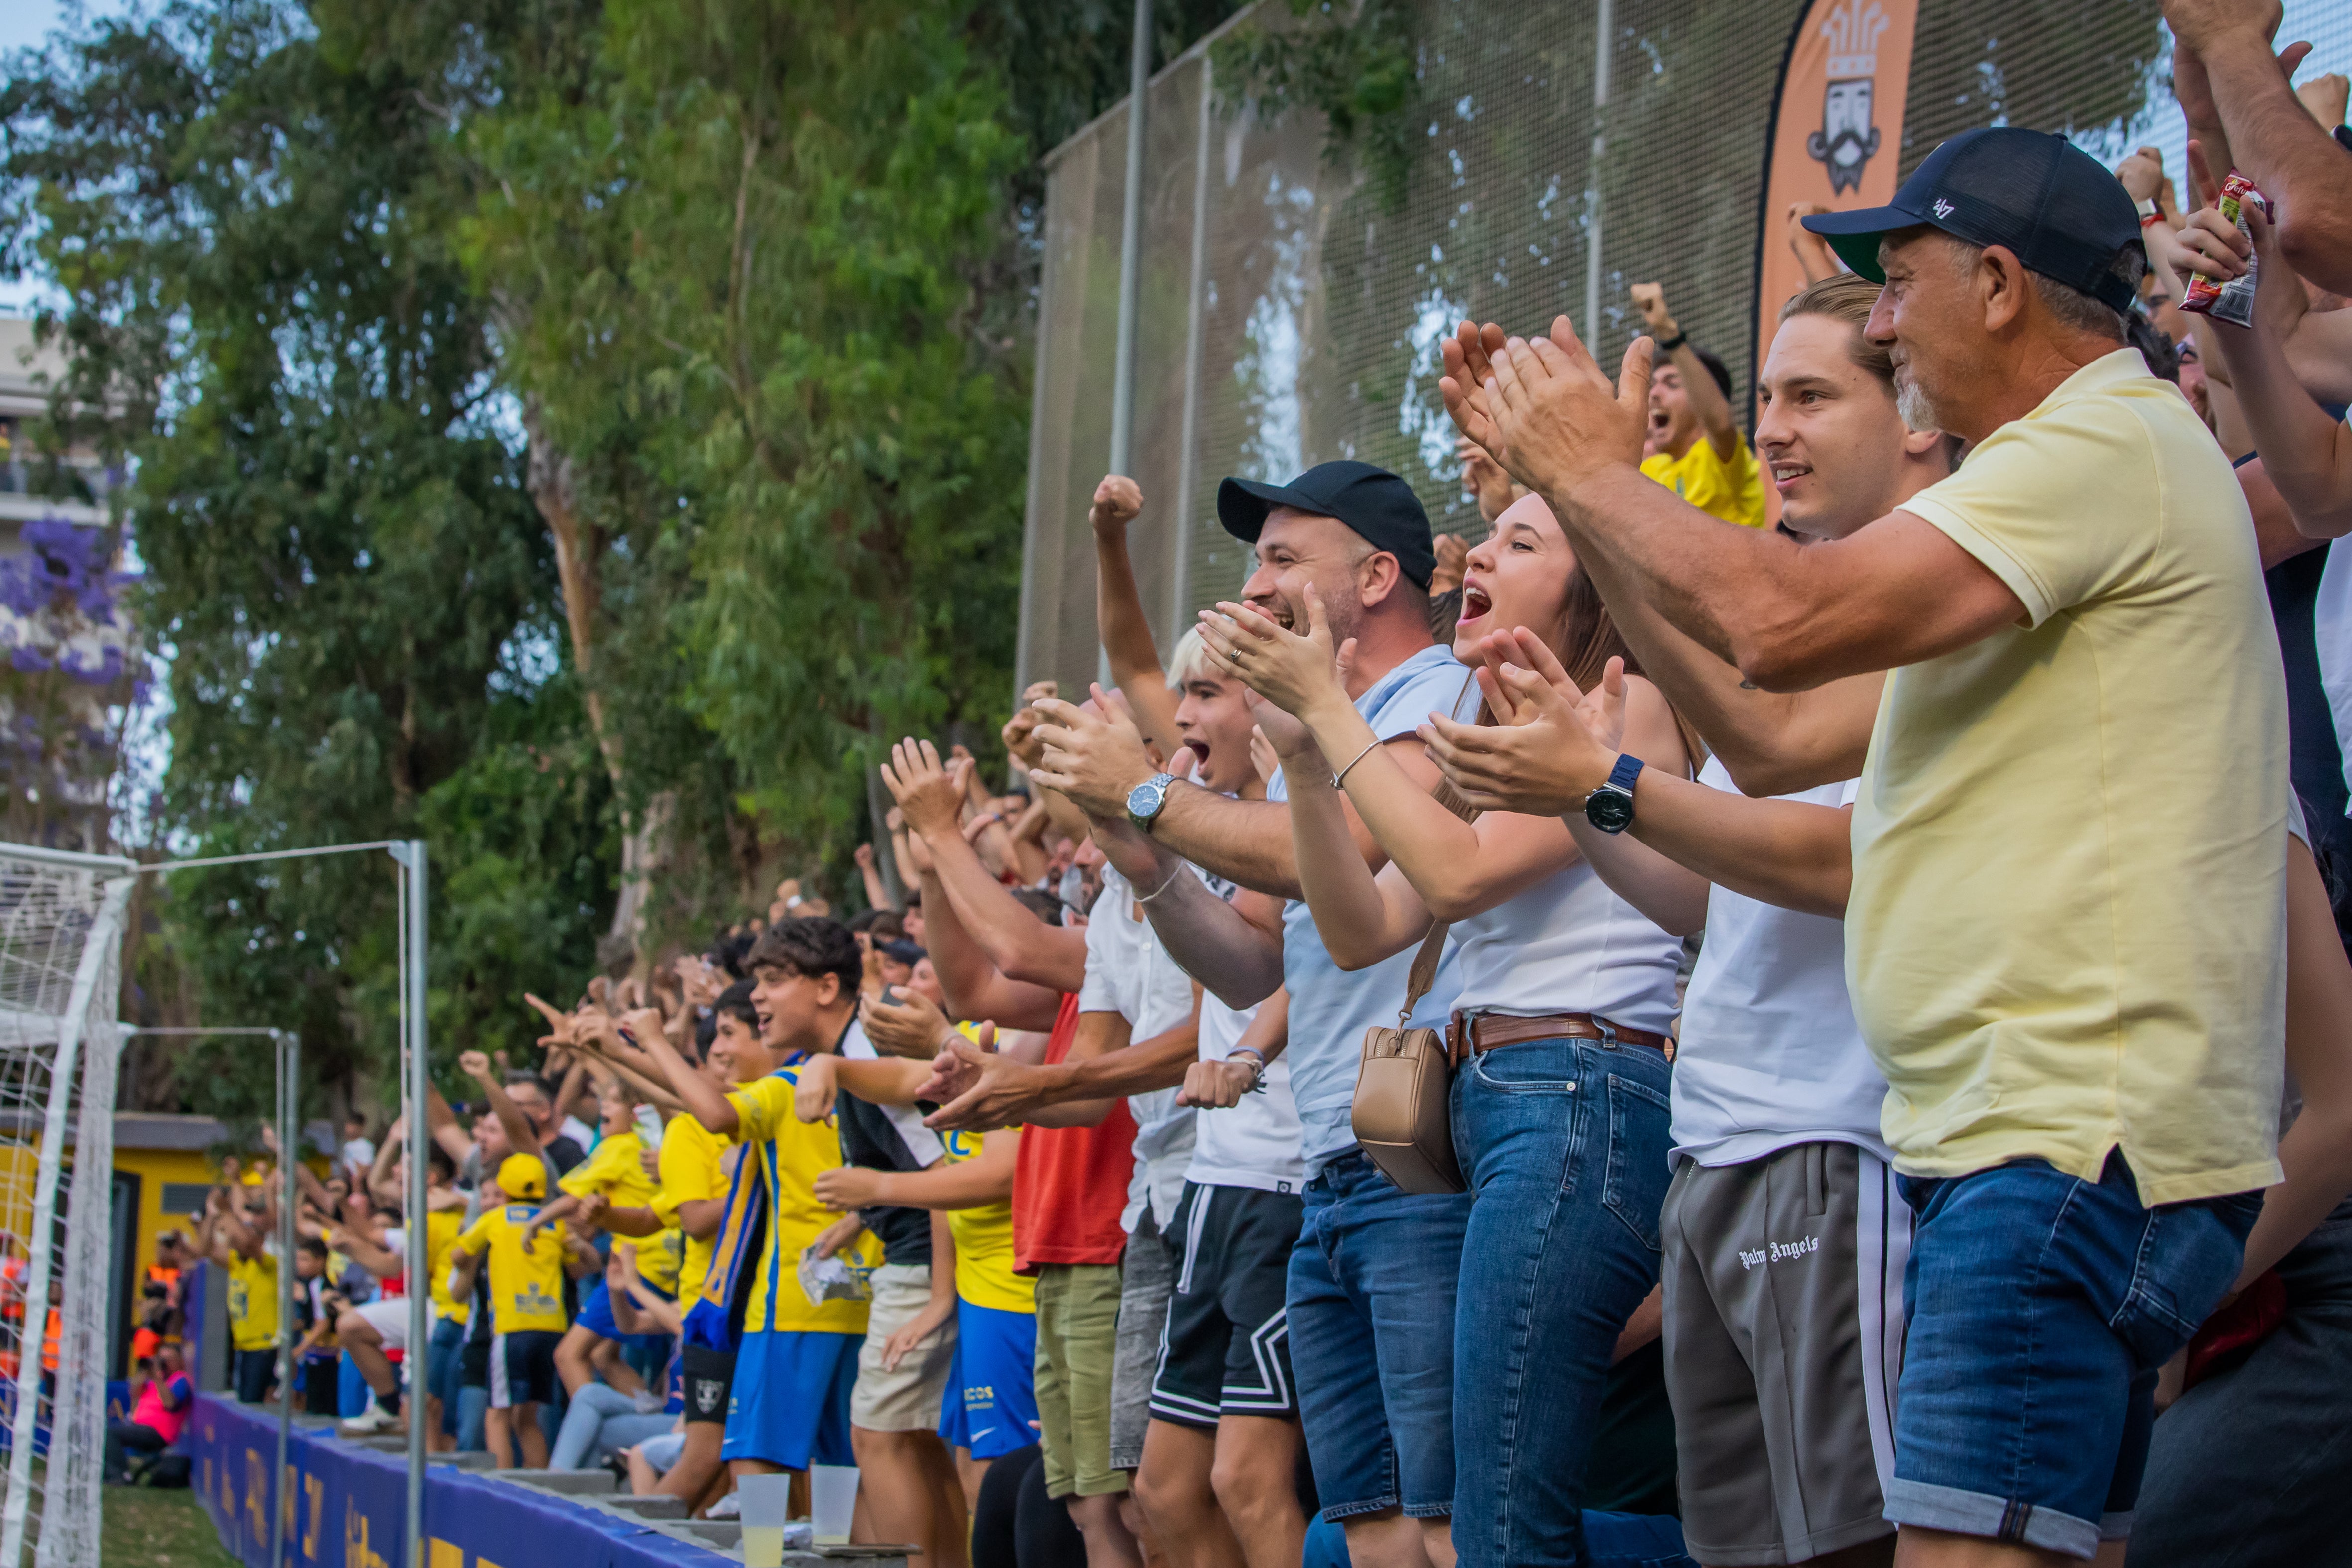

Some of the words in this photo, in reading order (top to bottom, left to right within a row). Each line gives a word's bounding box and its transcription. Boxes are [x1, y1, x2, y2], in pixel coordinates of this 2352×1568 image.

[2225, 182, 2246, 195] Grefu
[1739, 1247, 1766, 1270] Palm
[1770, 1235, 1818, 1262] Angels
